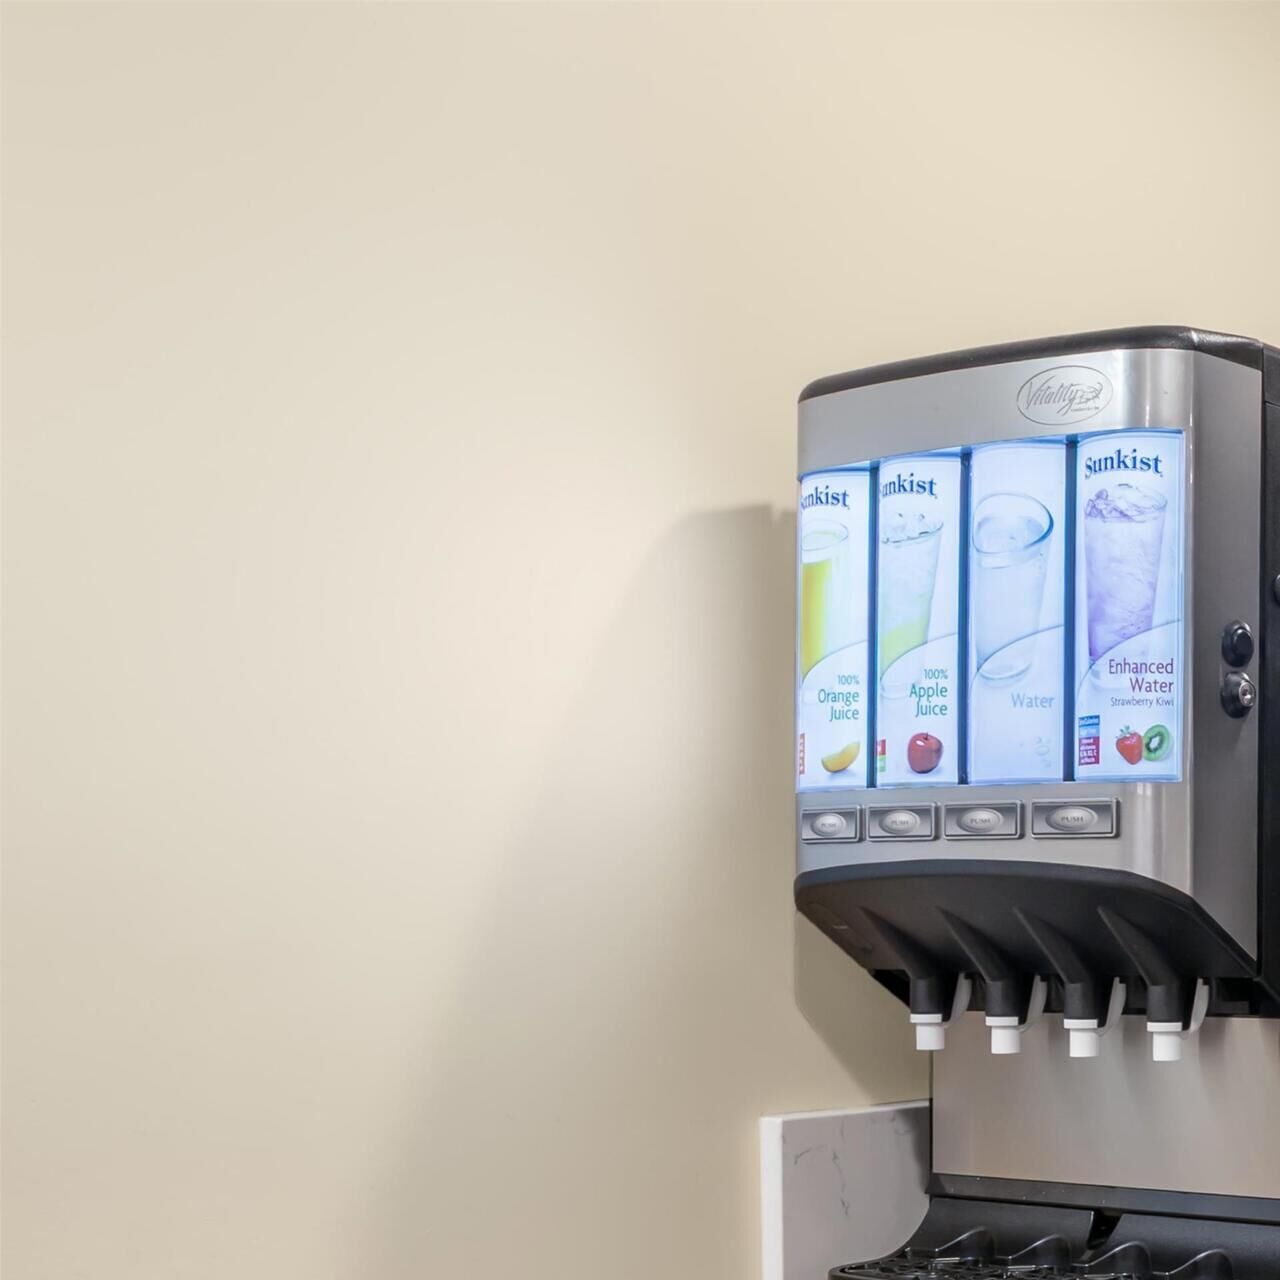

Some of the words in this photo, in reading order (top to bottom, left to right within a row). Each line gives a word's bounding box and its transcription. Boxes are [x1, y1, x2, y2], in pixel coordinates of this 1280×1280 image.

[1025, 375, 1077, 416] Vitality
[1084, 448, 1163, 479] Sunkist
[881, 472, 937, 498] unkist
[924, 668, 948, 680] 100%
[1108, 657, 1174, 675] Enhanced
[838, 674, 860, 686] 100%
[1129, 677, 1174, 693] Water
[818, 688, 860, 707] Orange
[909, 683, 948, 701] Apple
[1011, 692, 1055, 709] Water
[915, 701, 948, 718] Juice
[1110, 697, 1154, 709] Strawberry
[1156, 697, 1175, 707] Kiwi
[830, 706, 860, 722] Juice
[1060, 815, 1084, 823] PUSH
